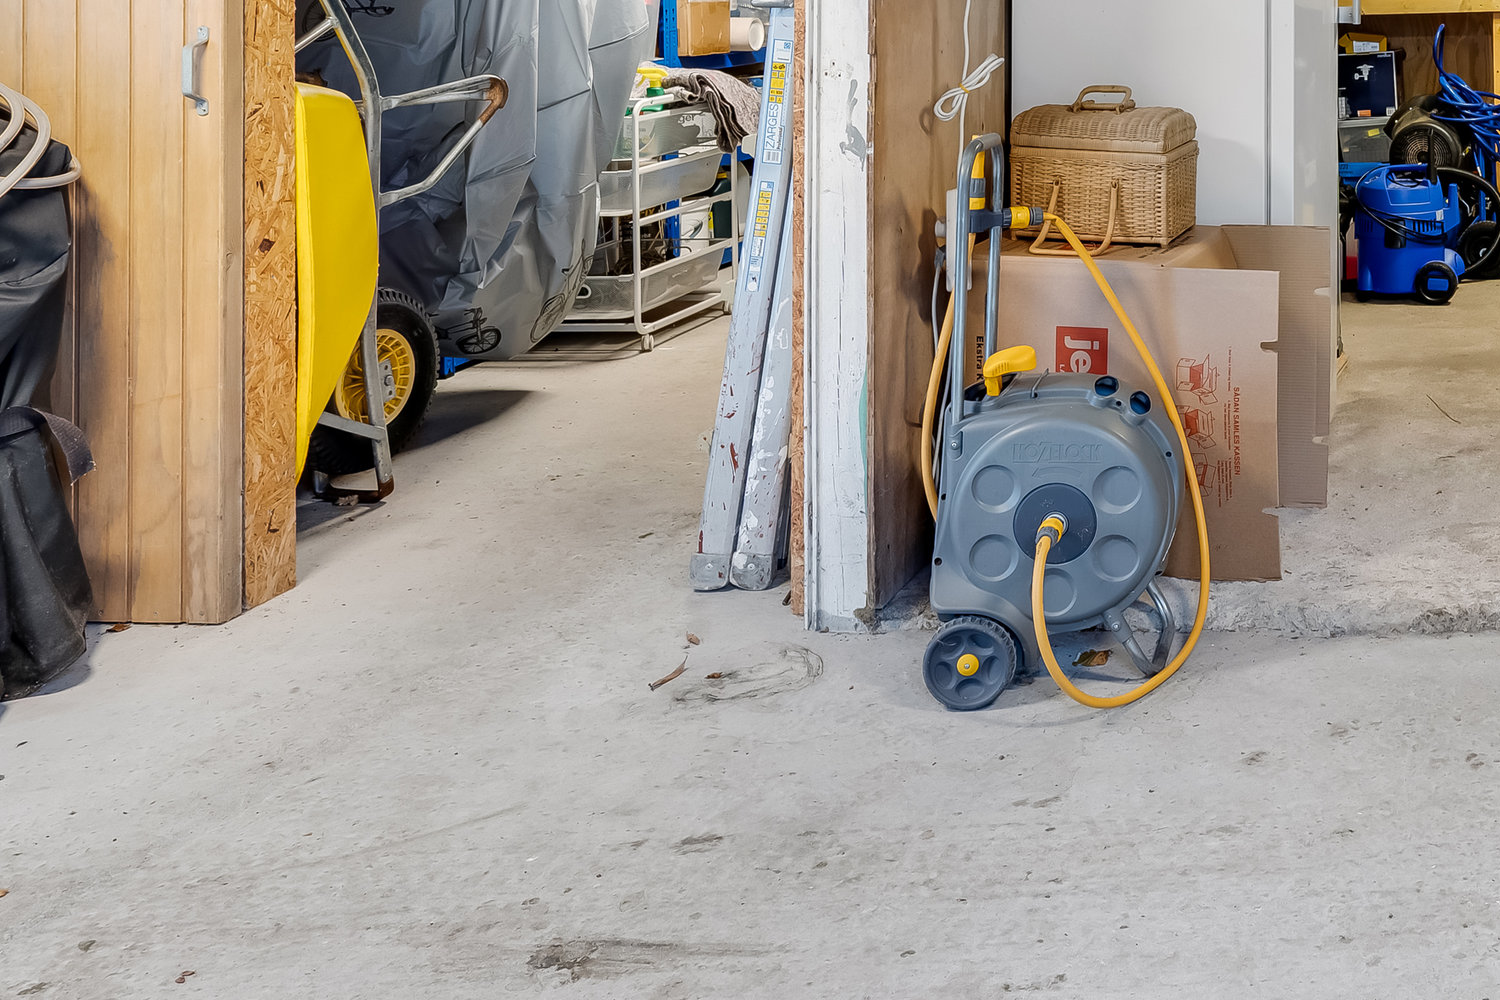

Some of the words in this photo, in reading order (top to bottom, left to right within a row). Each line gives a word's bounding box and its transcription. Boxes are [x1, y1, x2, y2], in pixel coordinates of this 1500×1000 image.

[766, 103, 779, 149] ZARGES
[976, 335, 984, 370] Ekstra
[1233, 386, 1241, 413] SÅDAN
[1233, 414, 1241, 445] SAMLES
[1233, 445, 1241, 476] KASSEN
